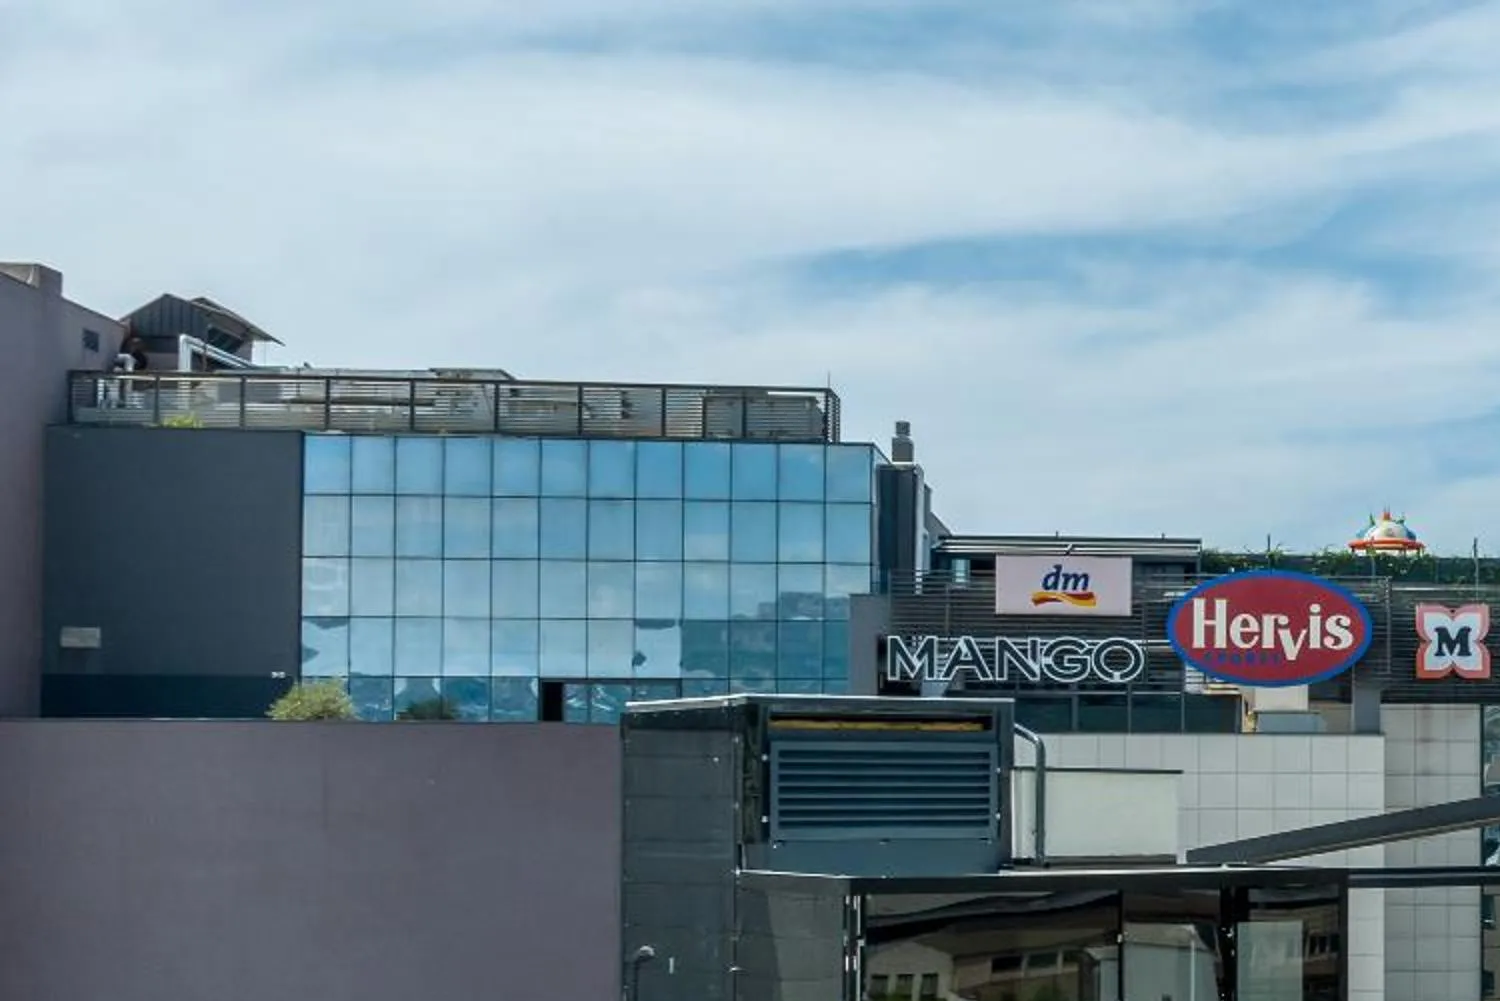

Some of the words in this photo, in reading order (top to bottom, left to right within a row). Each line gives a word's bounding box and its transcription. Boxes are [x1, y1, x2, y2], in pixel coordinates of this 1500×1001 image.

[1041, 564, 1090, 591] dm
[1190, 597, 1355, 661] Hervis
[1433, 626, 1473, 657] M
[886, 635, 1146, 683] MANGO
